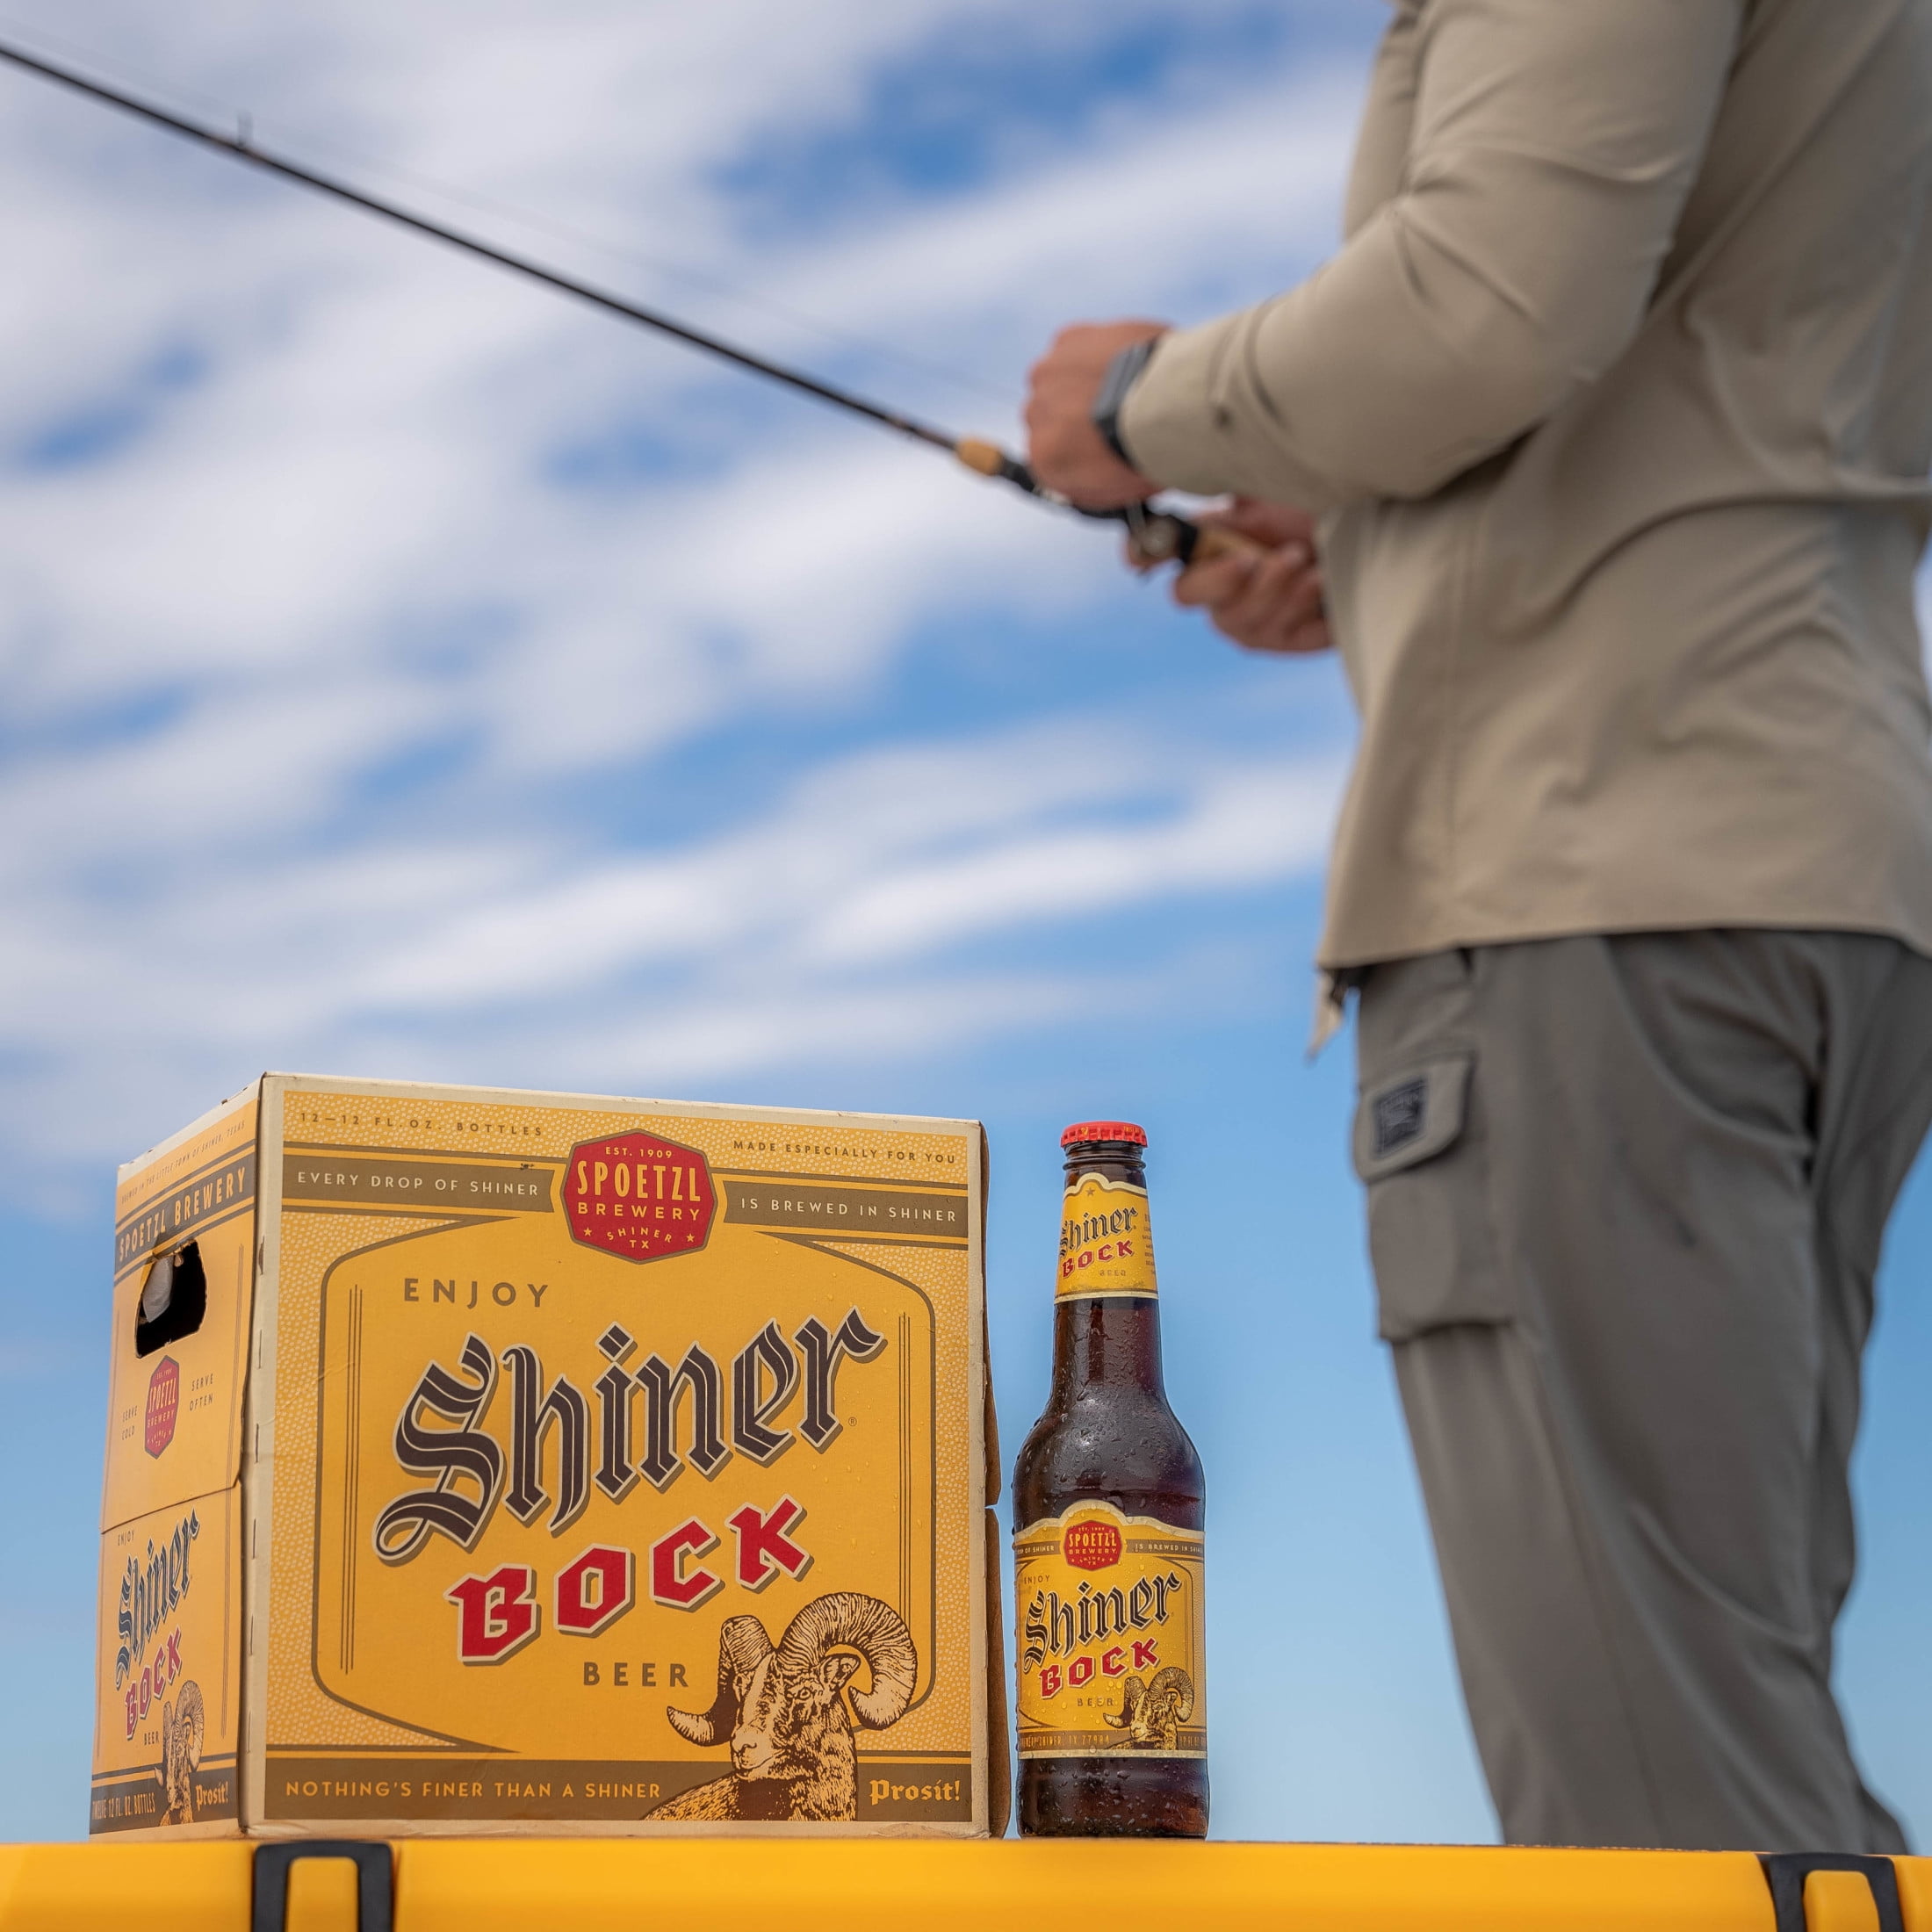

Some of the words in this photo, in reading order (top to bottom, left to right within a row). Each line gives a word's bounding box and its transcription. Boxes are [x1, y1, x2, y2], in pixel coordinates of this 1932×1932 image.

[457, 1122, 542, 1136] BOTTLES
[605, 1146, 633, 1157] EST.
[639, 1149, 673, 1158] 1909
[733, 1141, 776, 1152] MADE
[786, 1143, 877, 1158] ESPECIALLY
[888, 1150, 915, 1161] FOR
[926, 1153, 955, 1164] YOU
[298, 1171, 359, 1187] EVERY
[371, 1175, 423, 1189] DROP
[435, 1179, 459, 1191] OF
[470, 1181, 538, 1196] SHINER
[577, 1160, 701, 1202] SPOETZL
[119, 1209, 166, 1263] SPOETZL
[175, 1166, 246, 1226] BREWERY
[578, 1201, 700, 1221] BREWERY
[741, 1197, 759, 1209] IS
[771, 1199, 848, 1215] BREWED
[860, 1204, 877, 1216] IN
[889, 1207, 956, 1222] SHINER
[607, 1226, 672, 1243] SHINER
[630, 1239, 650, 1250] TX
[1062, 1238, 1135, 1280] BOCK
[404, 1278, 549, 1308] ENJOY
[148, 1377, 176, 1413] SPOETZL
[191, 1373, 213, 1392] SERVE
[189, 1393, 213, 1411] OFTEN
[371, 1306, 887, 1564] Shiner
[1069, 1532, 1117, 1548] SPOETZL
[443, 1494, 814, 1665] BOCK
[115, 1507, 200, 1691] Shiner
[1023, 1571, 1183, 1674] Shiner
[583, 1662, 689, 1688] BEER
[1038, 1637, 1160, 1700] BOCK
[126, 1625, 182, 1741] BOCK
[144, 1731, 159, 1746] BEER
[195, 1781, 228, 1812] Prosit!
[286, 1780, 412, 1798] NOTHING'S
[422, 1781, 483, 1798] FINER
[494, 1782, 551, 1798] THAN
[562, 1783, 574, 1798] A
[585, 1783, 660, 1799] SHINER
[869, 1778, 961, 1806] Prosit!
